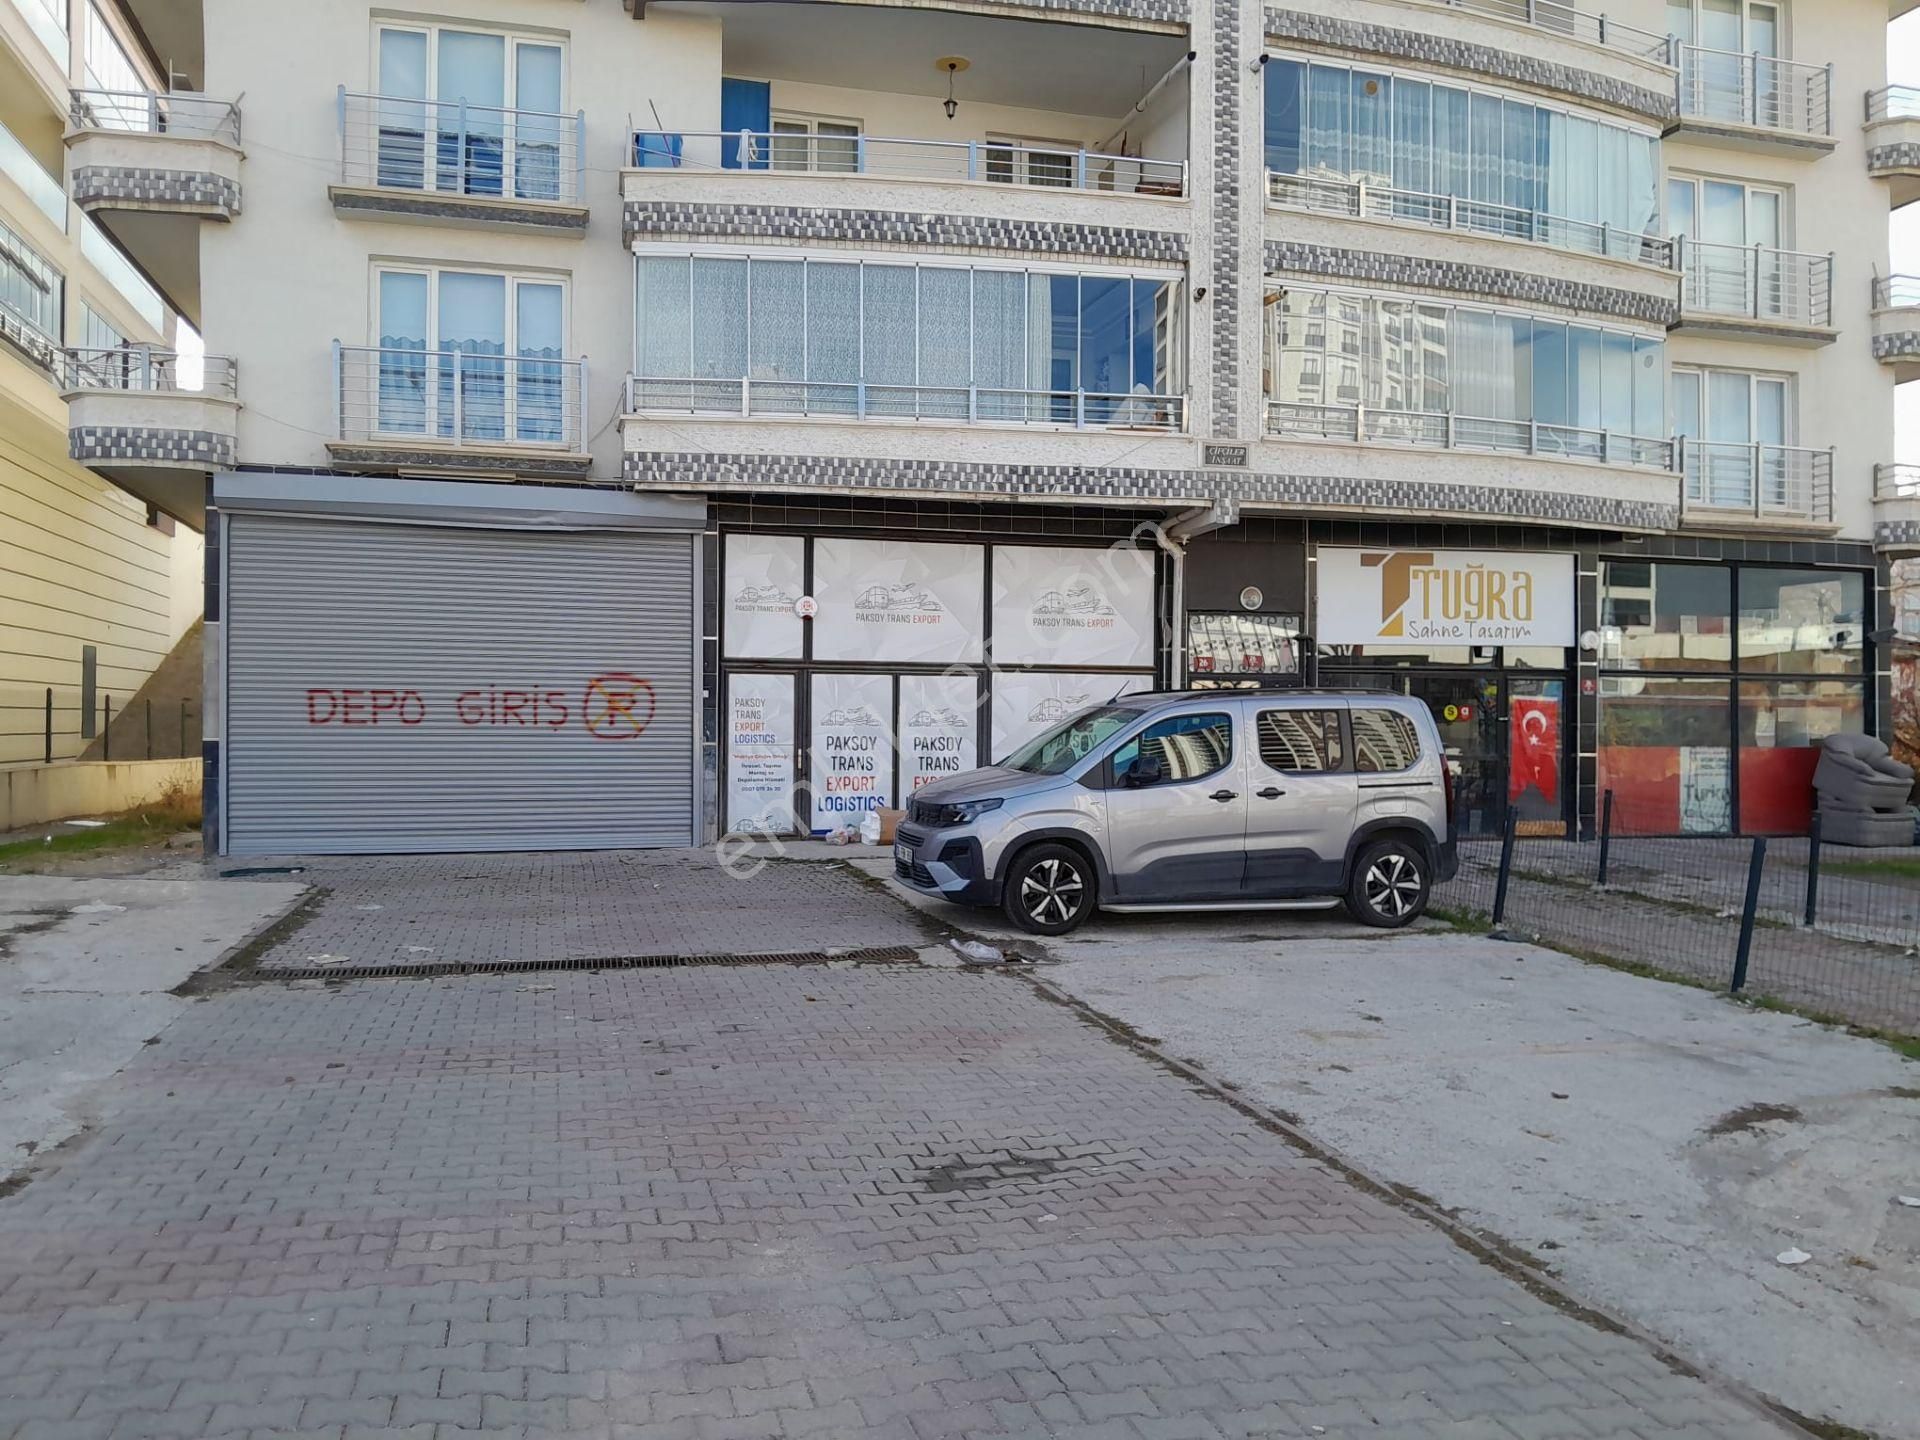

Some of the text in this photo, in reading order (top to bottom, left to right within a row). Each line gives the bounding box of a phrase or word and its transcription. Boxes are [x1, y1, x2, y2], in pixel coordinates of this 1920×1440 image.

[856, 613, 942, 624] PAKSOY TRANS EXPORT
[1032, 617, 1115, 628] PAKSOY TRANS EXPORT
[1409, 620, 1531, 639] Sahne Tasarım
[306, 689, 426, 725] DEPO
[734, 697, 766, 708] PAKSOY
[735, 709, 762, 720] TRANS
[734, 722, 766, 732] EXPORT
[734, 734, 776, 744] LOGISTICS
[826, 735, 877, 751] PAKSOY
[914, 736, 963, 751] PAKSOY
[831, 755, 874, 771] TRANS
[918, 755, 960, 771] TRANS
[826, 775, 876, 792] EXPORT
[818, 795, 886, 812] LOGISTICS
